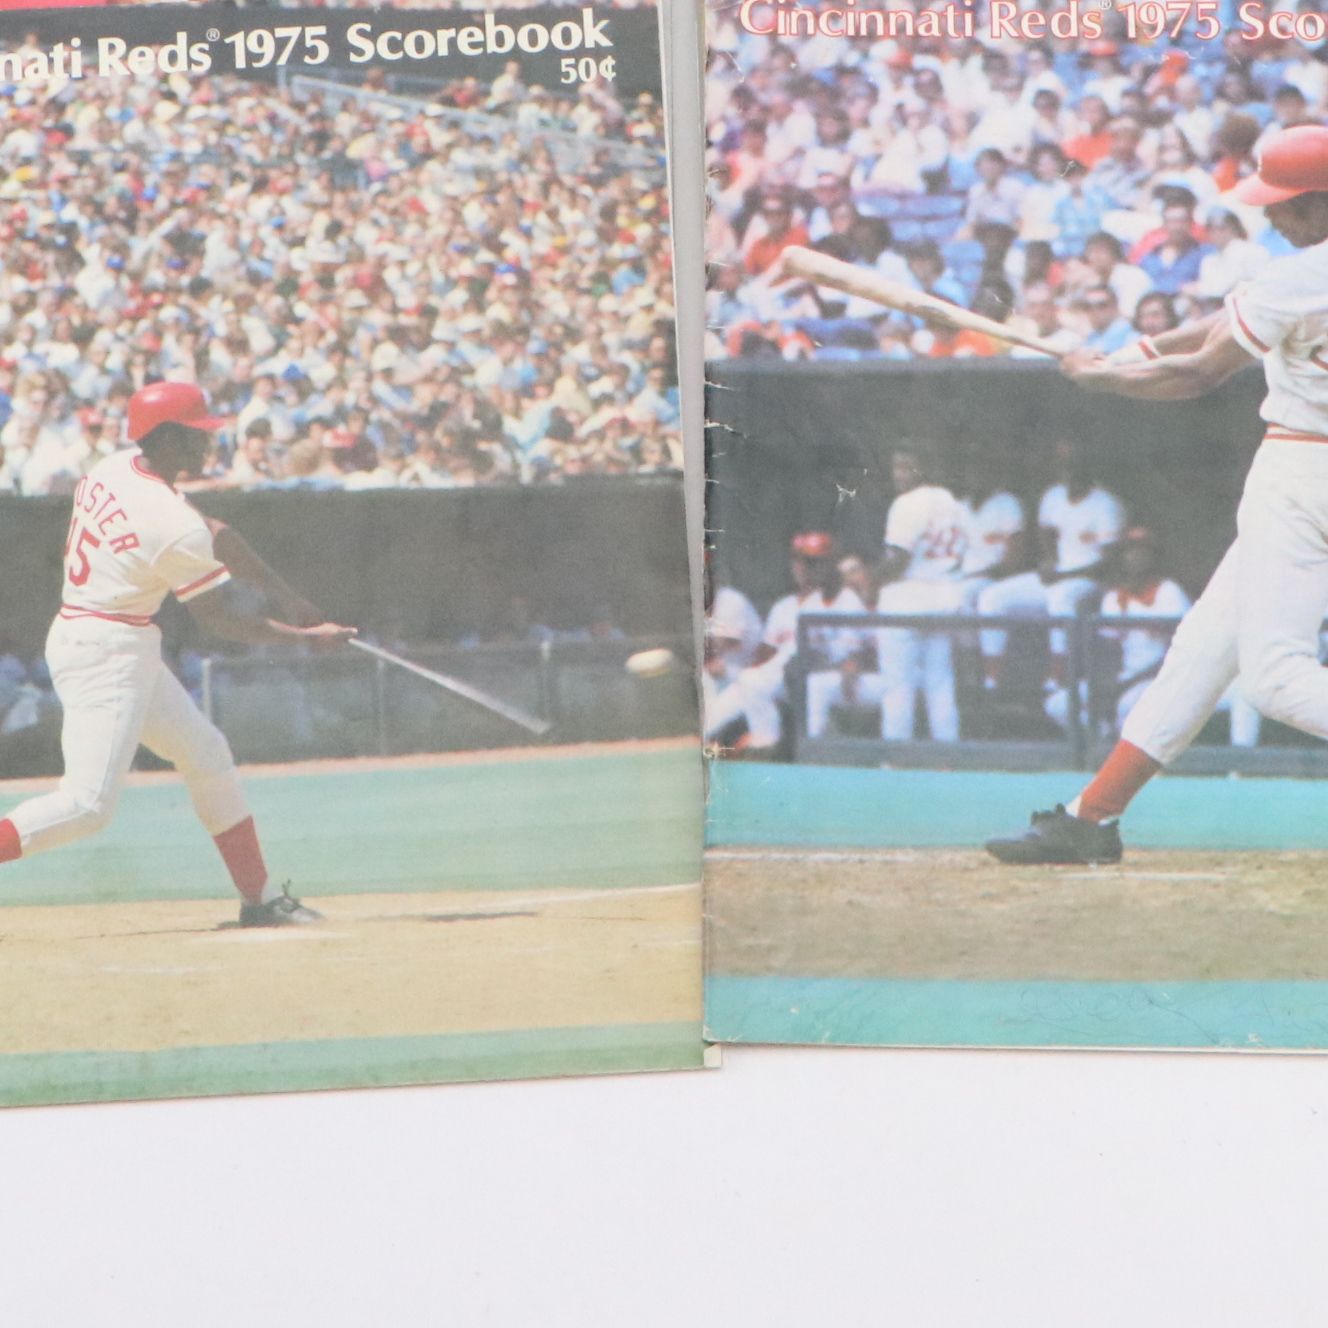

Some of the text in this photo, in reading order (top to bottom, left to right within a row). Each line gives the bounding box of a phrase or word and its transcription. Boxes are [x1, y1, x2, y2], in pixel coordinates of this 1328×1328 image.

[224, 22, 331, 67] 1975
[347, 7, 614, 65] Scorebook
[1116, 0, 1222, 41] 1975
